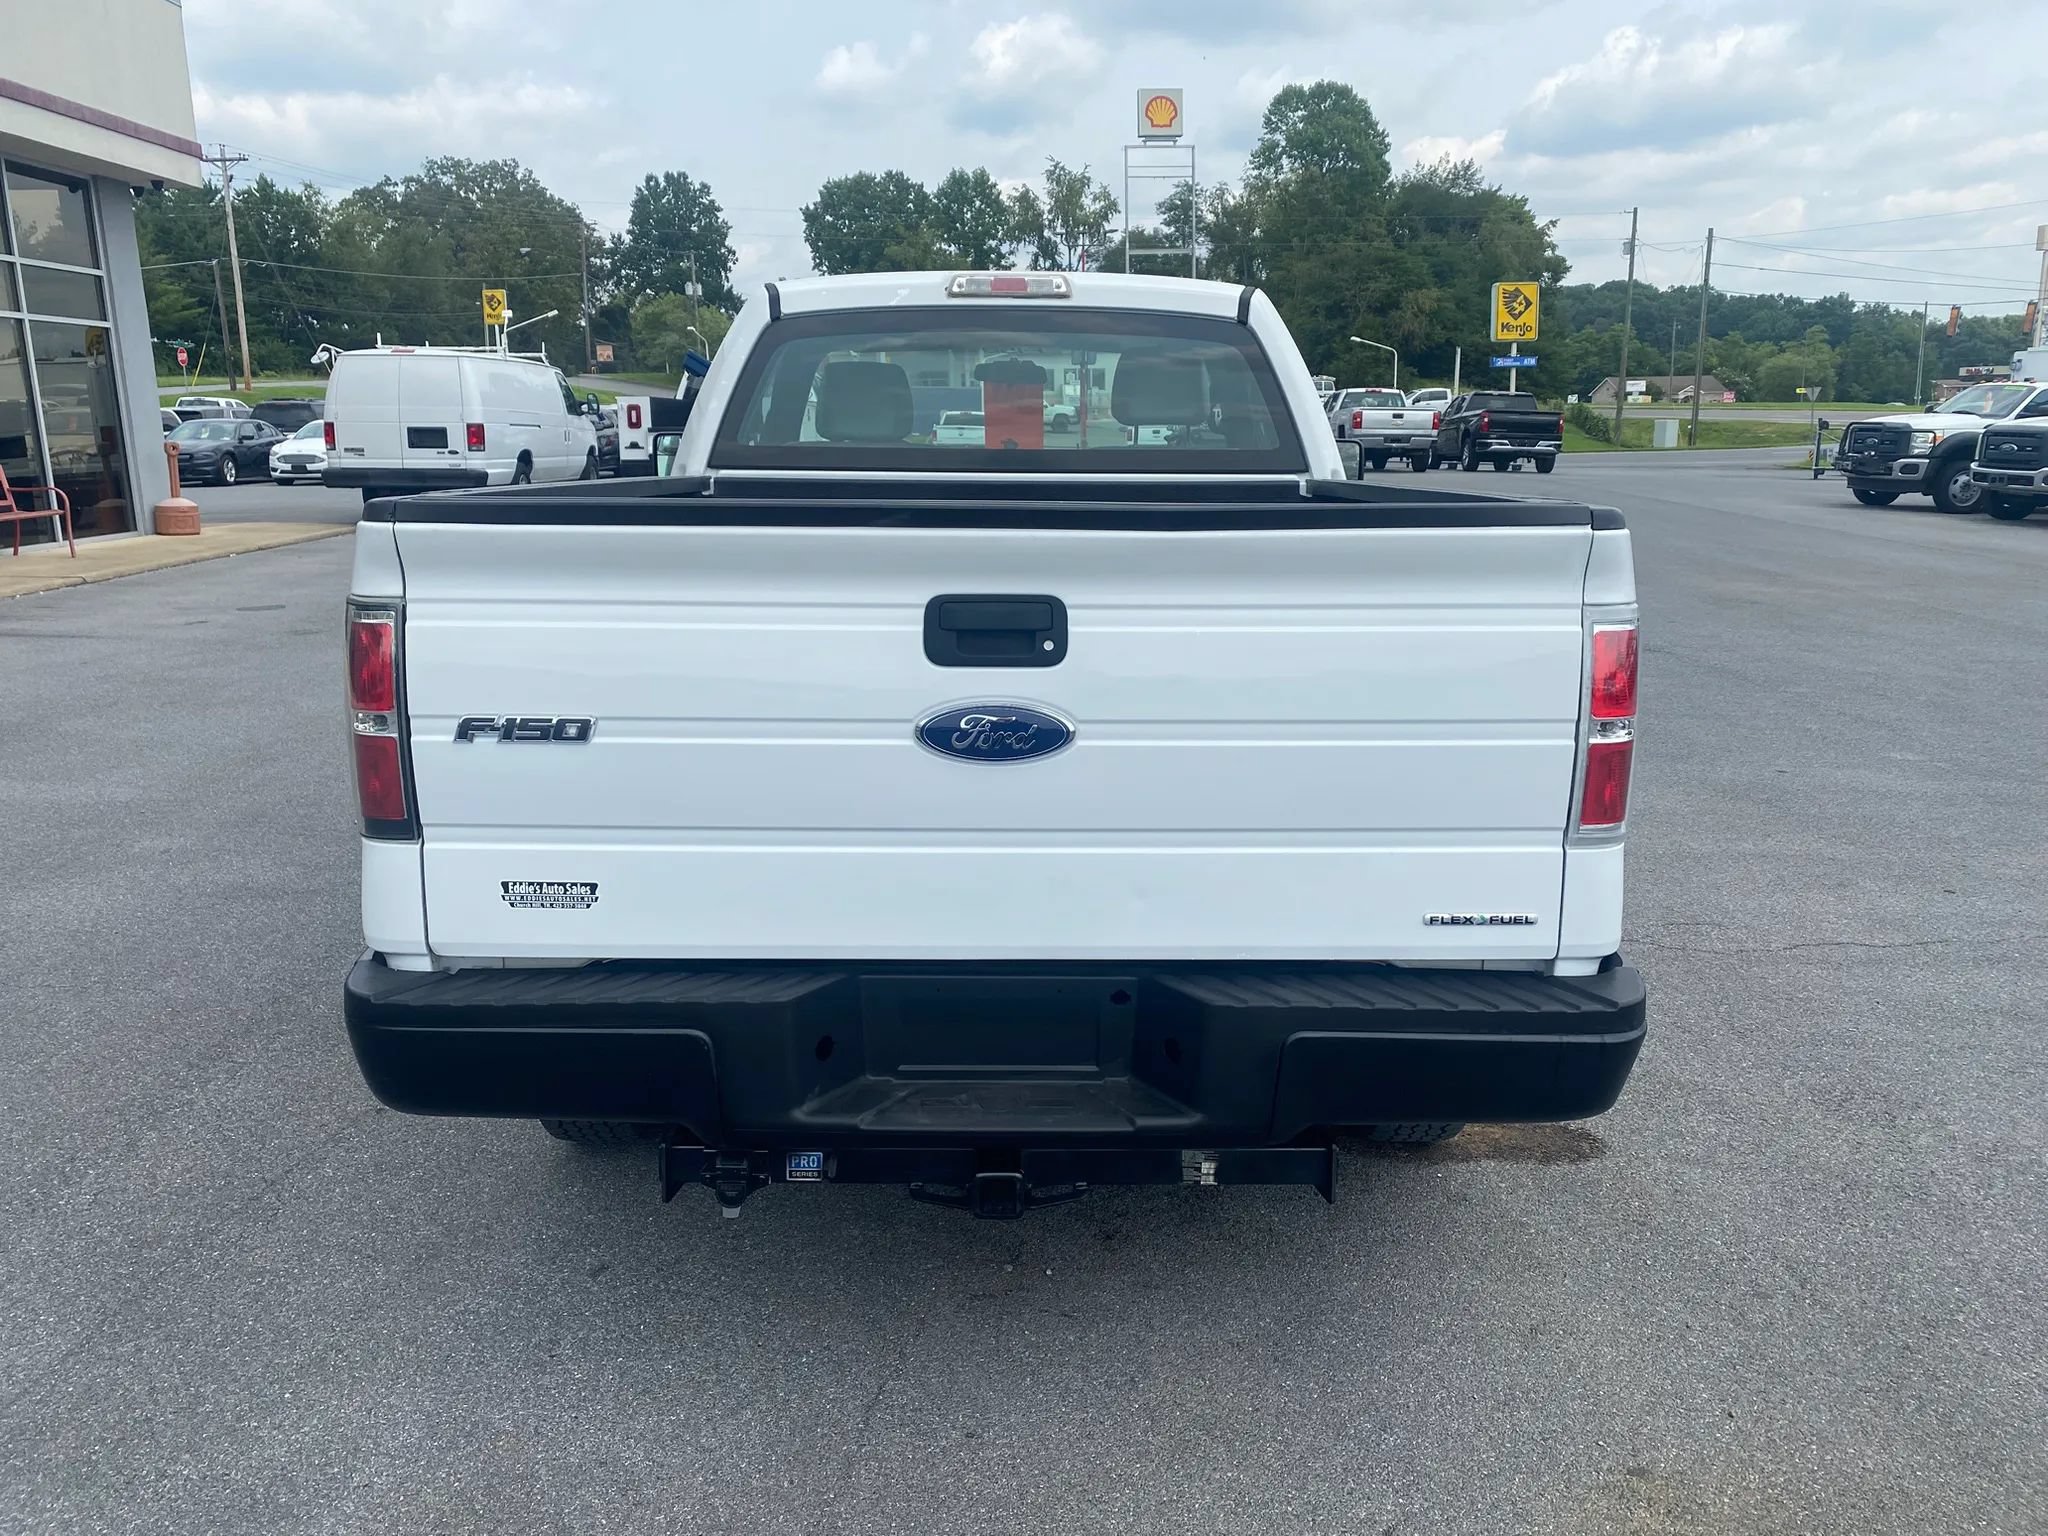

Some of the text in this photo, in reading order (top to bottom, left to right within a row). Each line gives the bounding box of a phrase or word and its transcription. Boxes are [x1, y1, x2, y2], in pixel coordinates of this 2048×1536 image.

[453, 714, 598, 744] F-150
[951, 714, 1038, 750] Ford
[508, 882, 591, 895] Eddie's Auto Sales
[1429, 916, 1534, 925] FLEX FUEL
[791, 1155, 818, 1168] PRO
